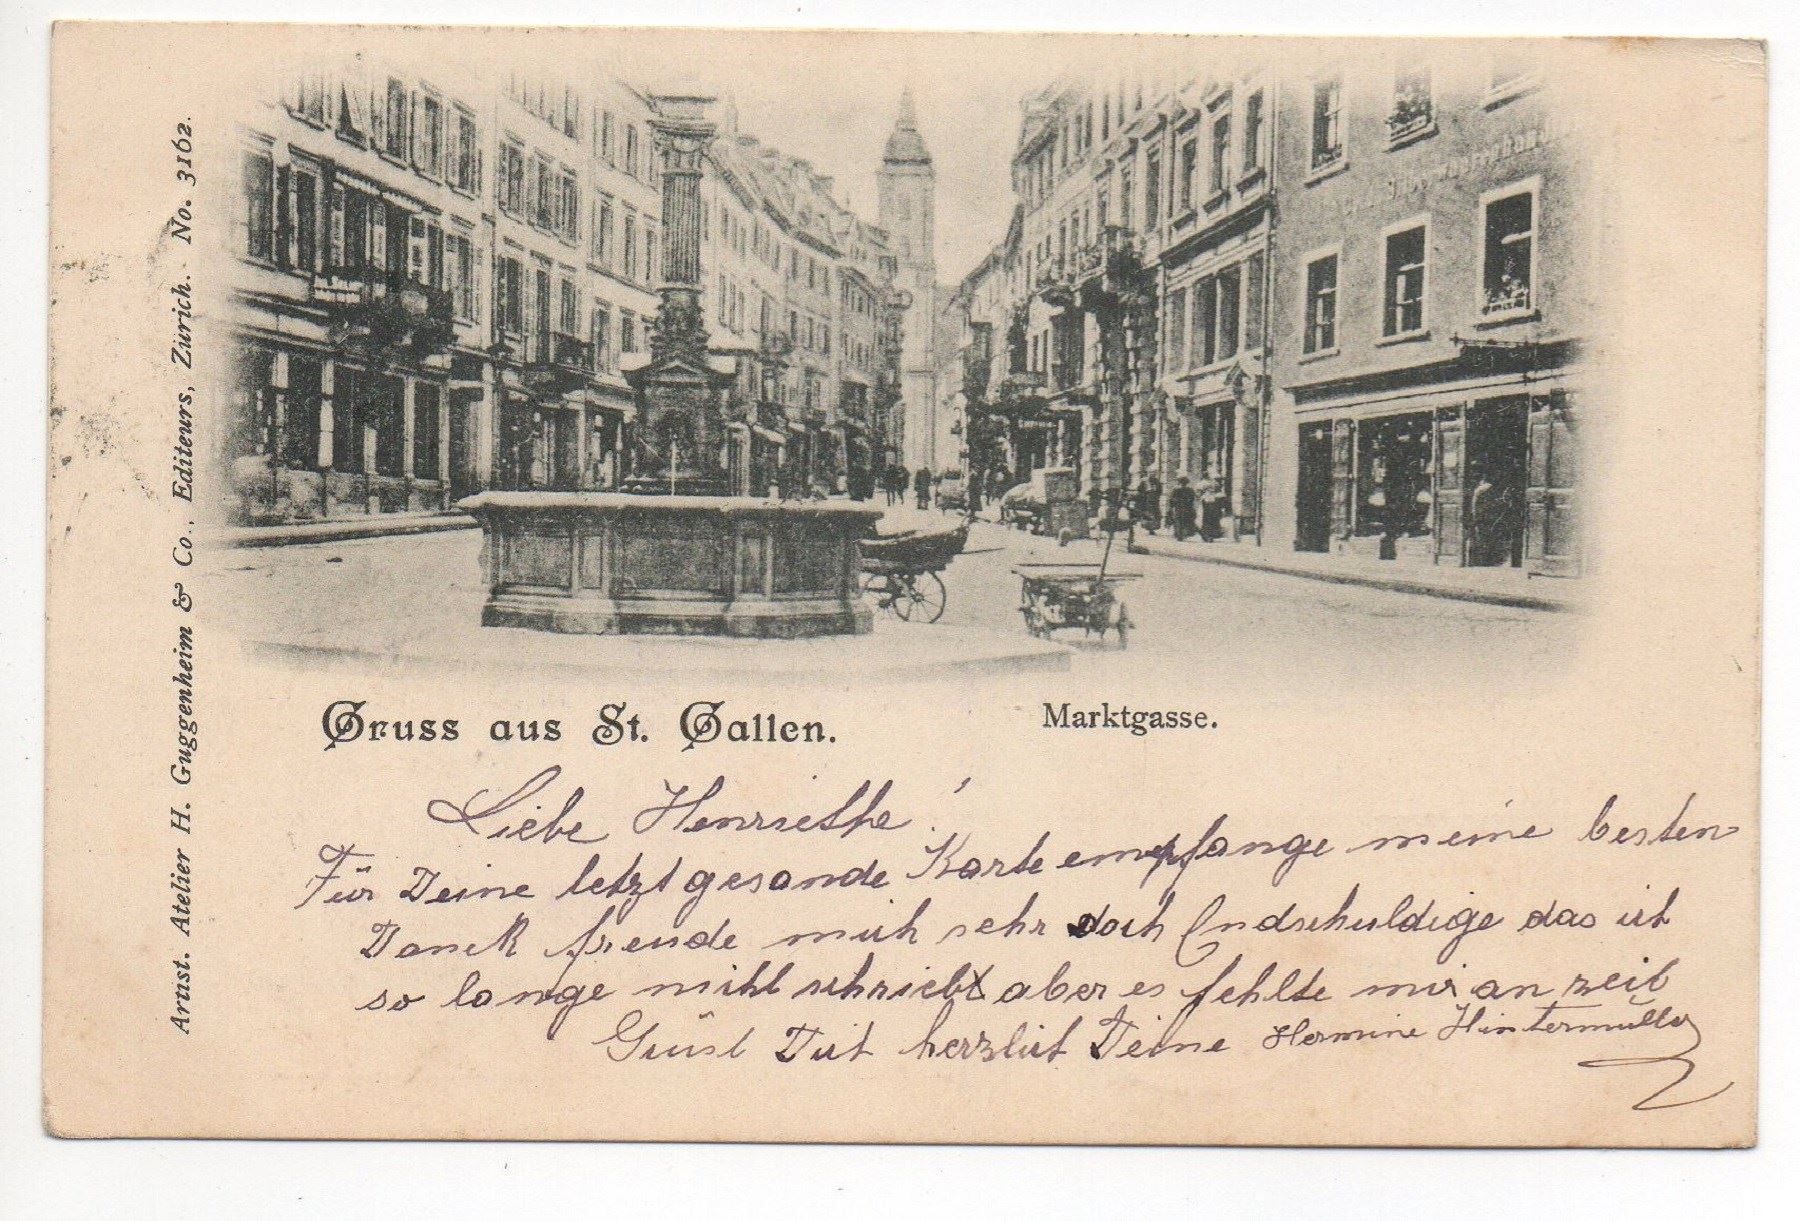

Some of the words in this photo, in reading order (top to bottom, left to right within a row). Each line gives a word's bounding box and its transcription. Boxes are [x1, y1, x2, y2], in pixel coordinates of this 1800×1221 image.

[170, 116, 197, 187] 3162.
[170, 199, 193, 245] No.
[170, 275, 192, 370] Zürich.
[171, 386, 196, 503] Editeurs,
[171, 581, 193, 613] &
[169, 625, 199, 785] Guggenheim
[321, 699, 460, 752] Gruss
[489, 719, 562, 742] aus
[591, 701, 649, 746] St.
[679, 700, 837, 753] Gallen.
[1042, 701, 1218, 737] Marktgasse.
[169, 802, 192, 835] H.
[426, 764, 610, 845] Liebe
[293, 843, 375, 910] Für
[398, 863, 536, 905] Deine
[905, 830, 1052, 880] Karte
[1345, 799, 1554, 854] meine
[1578, 792, 1740, 847] besten
[169, 847, 192, 938] Atelier
[941, 891, 1047, 941] sehr
[1519, 899, 1597, 932] das
[1615, 883, 1681, 930] ich
[354, 988, 426, 1012] so
[440, 969, 618, 1041] lange
[989, 960, 1108, 1005] aber
[1127, 980, 1166, 999] es
[1350, 963, 1466, 998] mir
[1466, 978, 1555, 1001] an
[1088, 1002, 1231, 1061] Deine
[1262, 1013, 1427, 1050] Hermine
